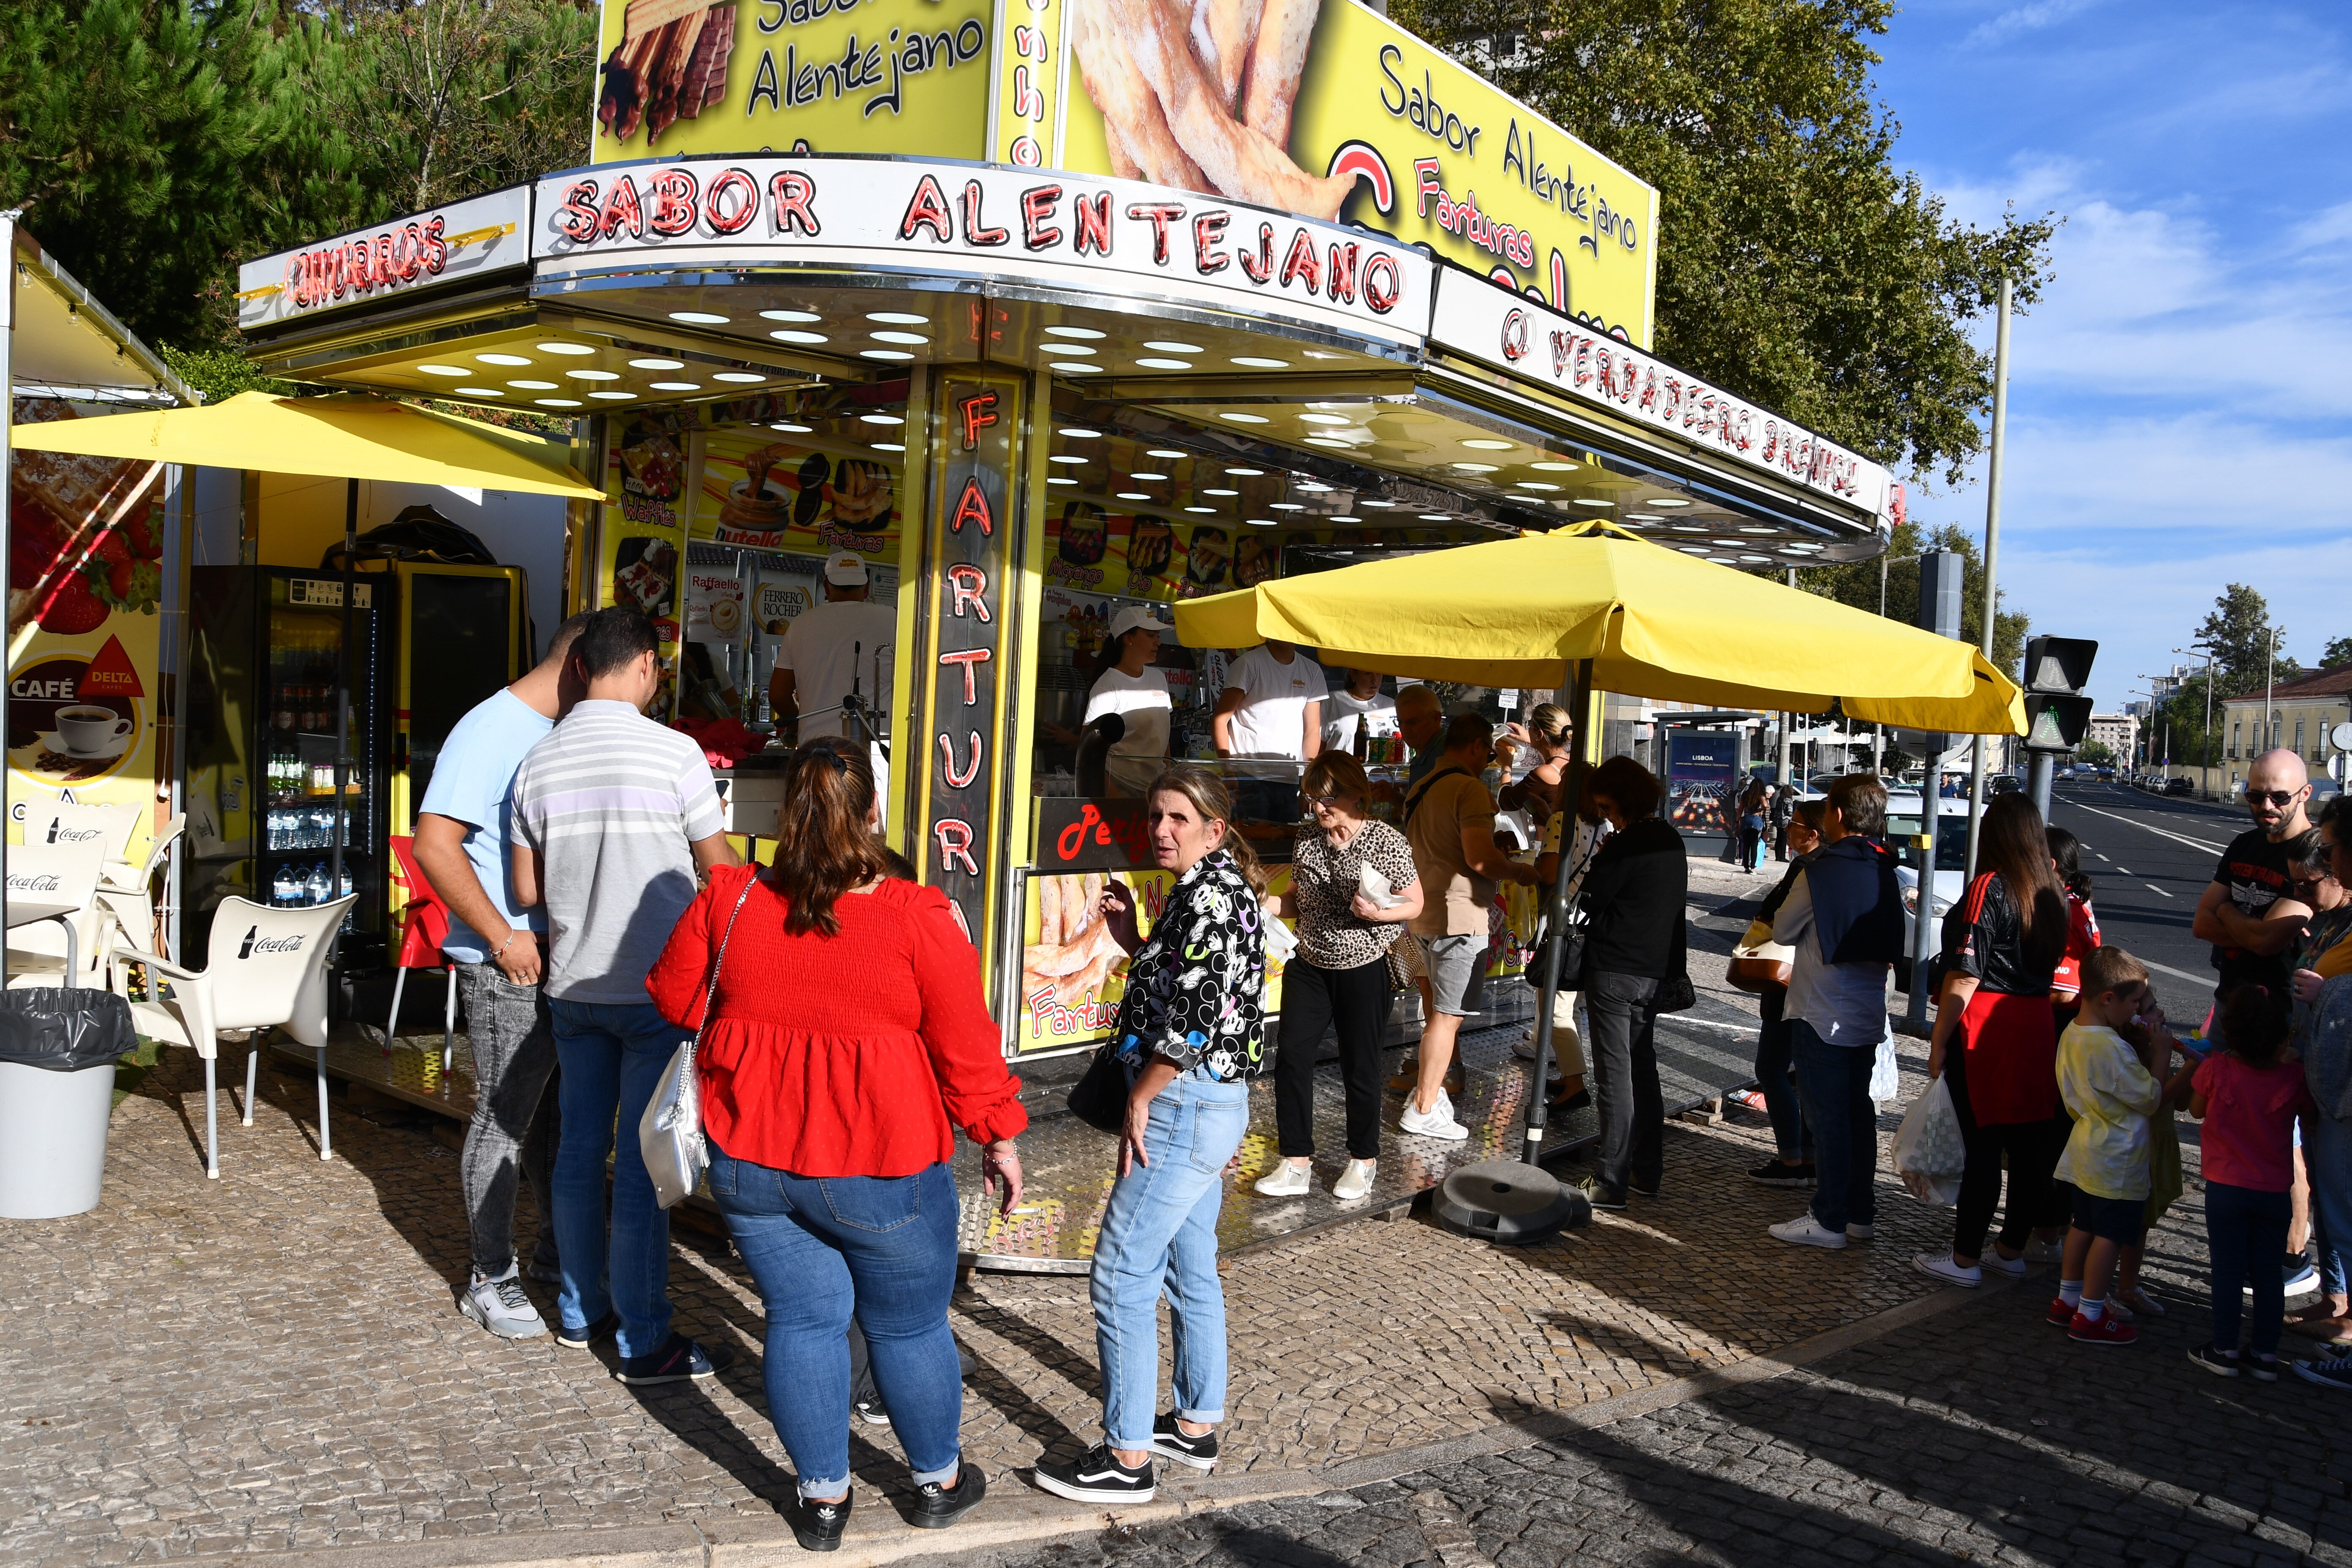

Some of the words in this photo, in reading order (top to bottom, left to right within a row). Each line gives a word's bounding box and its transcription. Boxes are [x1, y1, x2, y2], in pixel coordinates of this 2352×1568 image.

[747, 19, 985, 118] Alentejano
[1379, 44, 1481, 158] Sabor
[1504, 117, 1637, 259] Alentejano
[1414, 157, 1533, 268] Farturas
[561, 169, 821, 243] SABOR
[901, 174, 1405, 315] ALENTEJANO
[284, 214, 447, 308] CHURROS
[1501, 307, 1537, 363] O
[1549, 328, 1760, 452] VERDADEIRO
[621, 493, 676, 527] Waffles
[716, 527, 783, 547] nutella
[818, 520, 884, 553] Farturas
[693, 576, 740, 590] Raffaello
[1048, 556, 1104, 591] Morango
[1128, 568, 1152, 591] Ovo
[764, 590, 804, 604] FERRERO
[764, 603, 802, 617] ROCHER
[12, 678, 74, 698] CAFÉ
[92, 672, 133, 683] DELTA
[1165, 668, 1193, 686] tella
[254, 934, 308, 953] Coca-Cola
